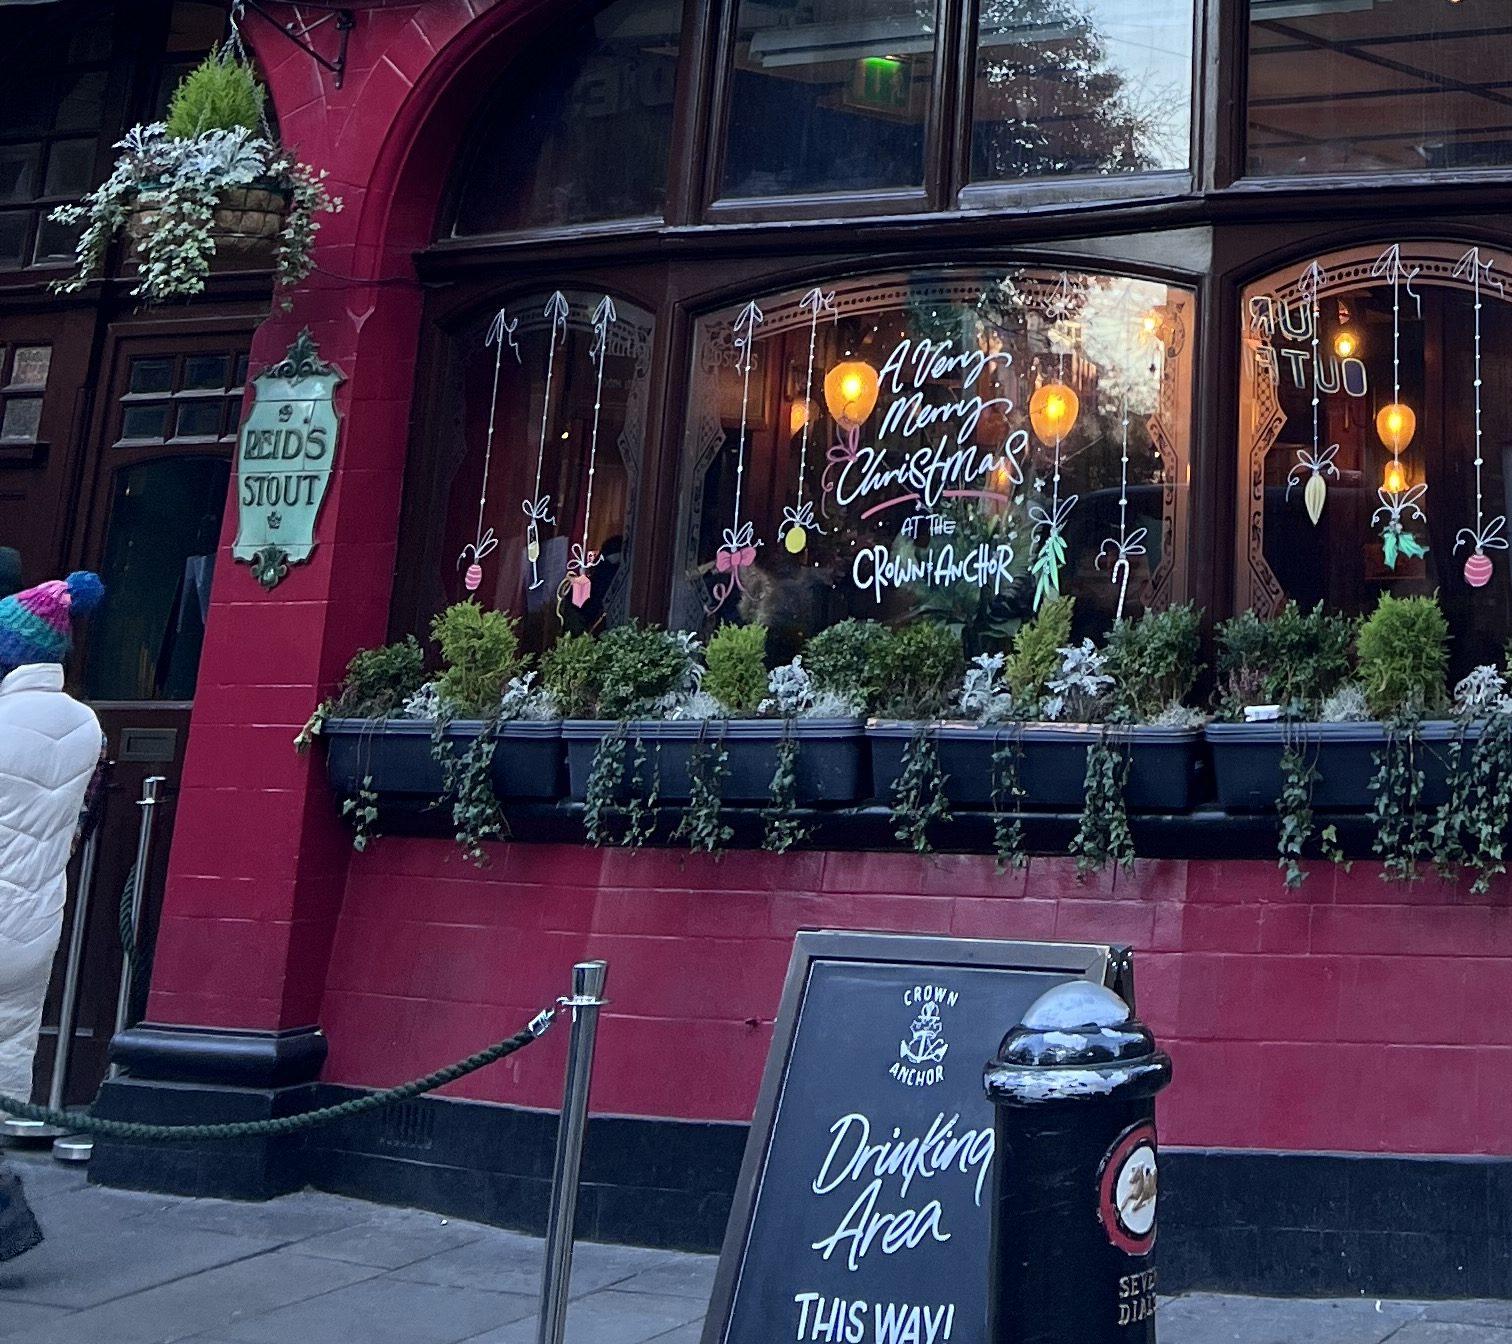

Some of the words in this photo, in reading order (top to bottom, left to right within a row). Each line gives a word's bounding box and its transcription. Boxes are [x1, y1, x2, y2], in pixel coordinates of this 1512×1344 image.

[878, 338, 911, 394] A
[911, 338, 1013, 391] Very
[878, 391, 1013, 444] Merry
[242, 474, 321, 507] STOUT
[900, 515, 924, 540] AT
[927, 514, 957, 537] THE
[903, 984, 959, 1008] CROWN
[888, 1062, 944, 1087] ANCHOR
[811, 1179, 951, 1272] Area
[794, 1291, 869, 1343] THIS
[872, 1302, 956, 1344] WAY!
